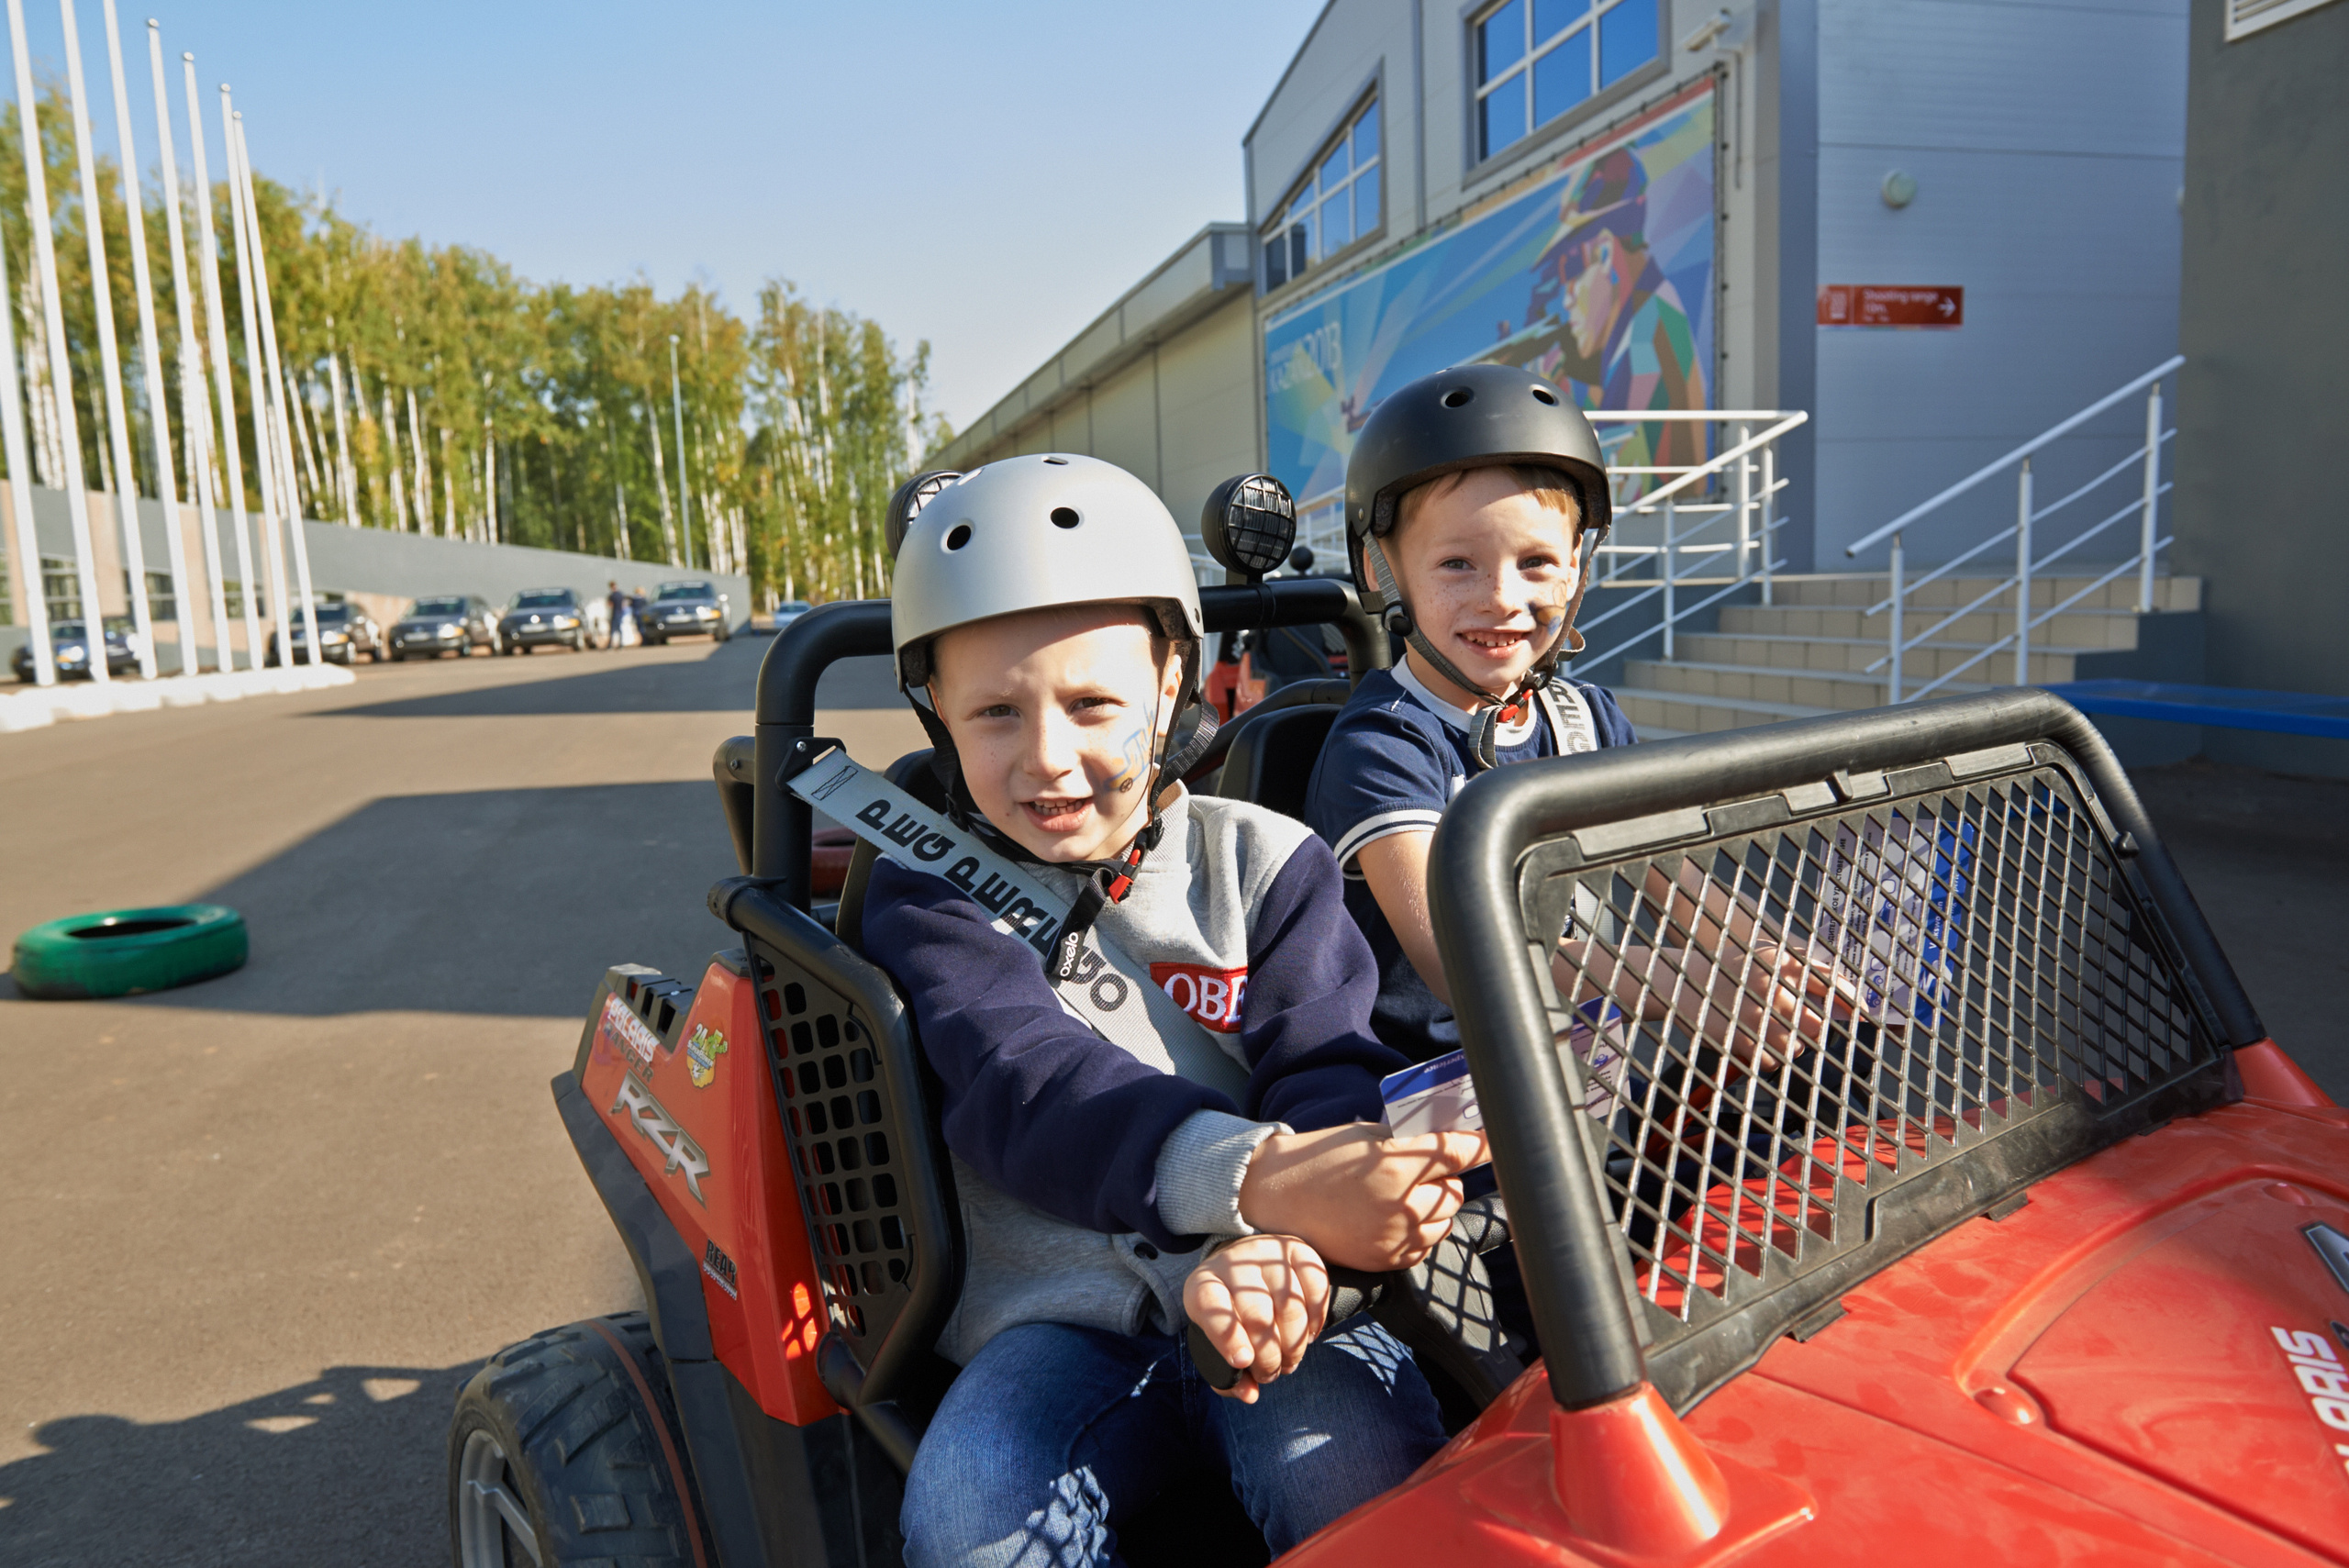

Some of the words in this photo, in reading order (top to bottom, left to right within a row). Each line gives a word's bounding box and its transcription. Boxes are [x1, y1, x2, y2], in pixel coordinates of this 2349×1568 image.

[855, 799, 956, 862] PEG
[1059, 931, 1079, 977] oxelo
[603, 1020, 654, 1082] RANGER
[608, 997, 660, 1062] POLARIS
[1423, 1053, 1465, 1074] xperience
[611, 1067, 710, 1209] RZR
[706, 1239, 737, 1285] REAR
[2270, 1326, 2349, 1474] ARIS
